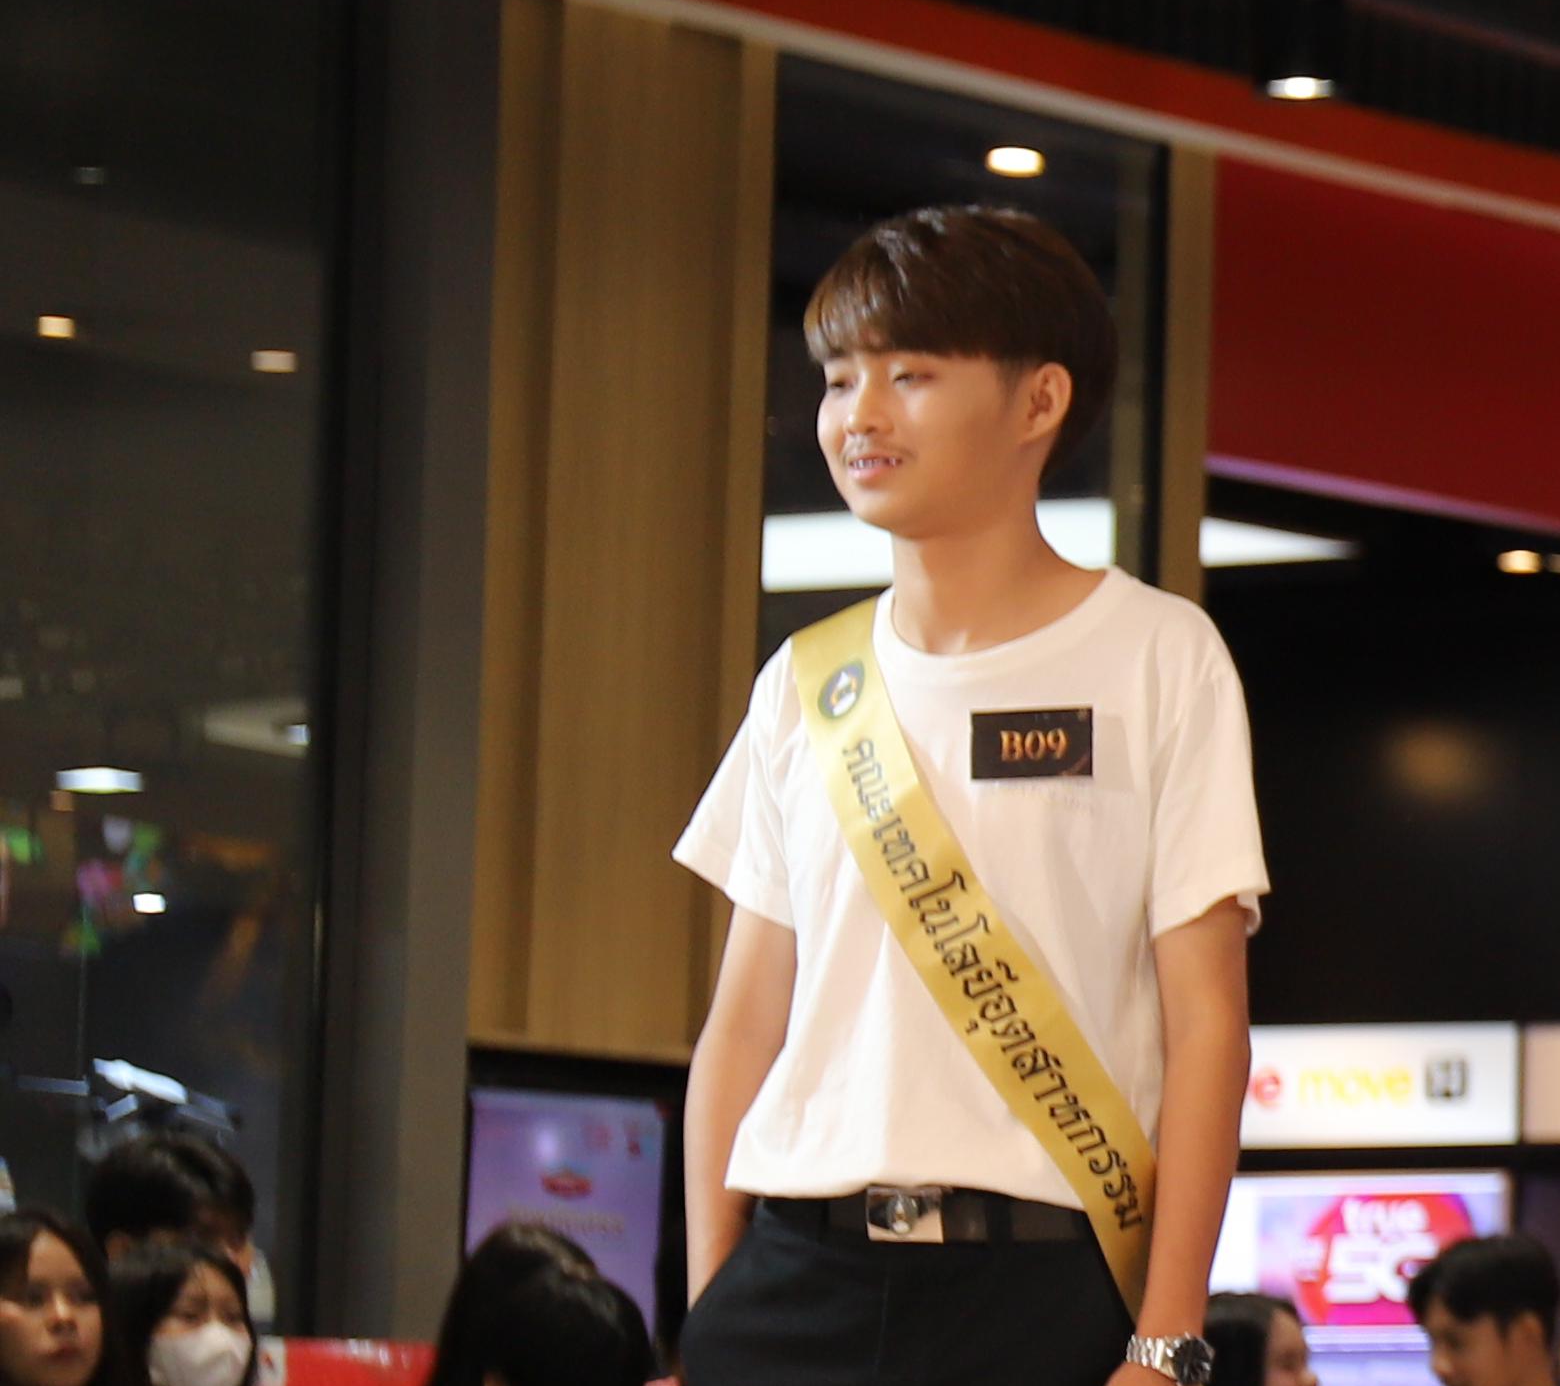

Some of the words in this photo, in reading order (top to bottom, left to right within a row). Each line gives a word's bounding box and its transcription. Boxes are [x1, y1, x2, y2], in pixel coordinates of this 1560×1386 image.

[1000, 727, 1069, 762] B09
[840, 737, 1145, 1233] คณะเทคโนโลยีอุตสาหกรรม
